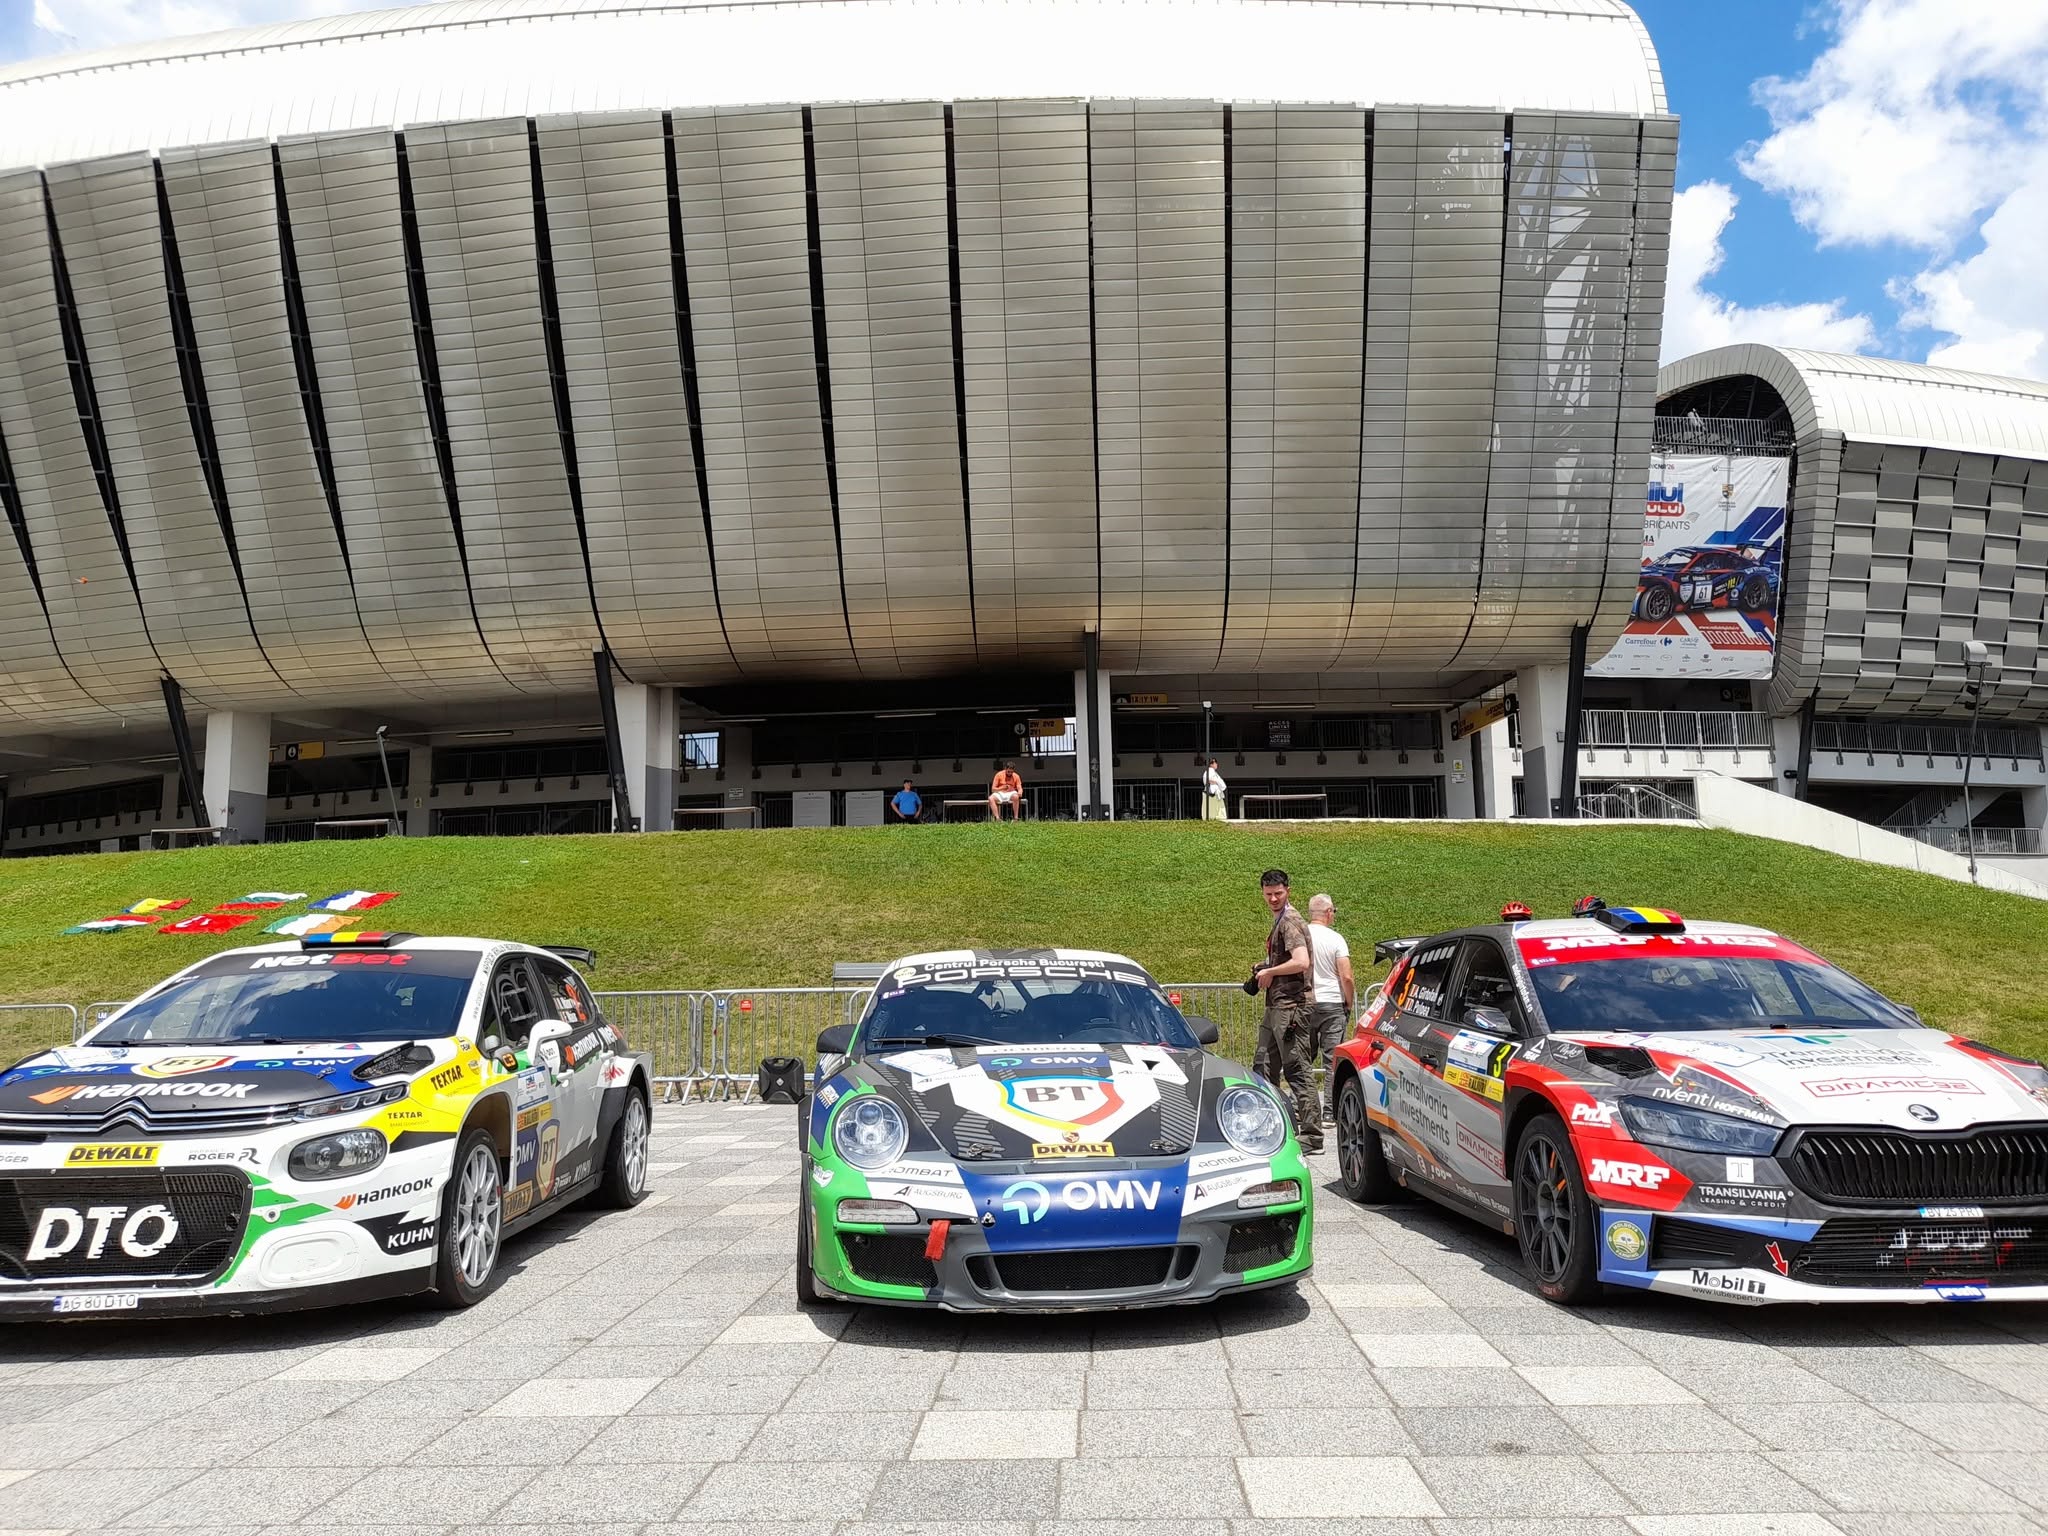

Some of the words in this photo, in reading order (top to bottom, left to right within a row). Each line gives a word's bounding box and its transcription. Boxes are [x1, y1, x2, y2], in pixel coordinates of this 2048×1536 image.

[1625, 637, 1657, 645] Carrefour
[249, 953, 412, 969] NetBet
[924, 960, 976, 971] Centrul
[983, 959, 1037, 967] Porsche
[898, 967, 1148, 988] PORSCHE
[1397, 968, 1415, 1007] 3
[1494, 1043, 1511, 1077] 3
[1764, 1048, 1917, 1058] Transilvania
[1777, 1055, 1932, 1066] Investments
[165, 1058, 209, 1068] BT
[292, 1058, 354, 1067] OMV
[430, 1064, 464, 1091] TEXTAR
[1023, 1085, 1094, 1103] BT
[1399, 1070, 1449, 1121] Transilvania
[387, 1111, 423, 1120] TEXTAR
[1713, 1101, 1775, 1124] HOFFMAN
[1402, 1099, 1450, 1146] Investments
[188, 1152, 235, 1161] ROGER
[542, 1137, 555, 1165] BT
[1588, 1158, 1670, 1190] MRF
[914, 1188, 963, 1200] AUGSBURG
[1062, 1180, 1162, 1211] OMV
[1698, 1186, 1787, 1201] TRANSILVANIA
[1927, 1207, 1941, 1217] BV
[25, 1204, 179, 1261] DTO
[387, 1226, 434, 1249] KUHN
[1692, 1269, 1744, 1291] Mobil
[1749, 1280, 1766, 1295] 1
[63, 1297, 81, 1311] AG
[84, 1296, 101, 1310] 80
[104, 1294, 136, 1308] DTO
[1692, 1287, 1765, 1303] www.lubexpert.ro
